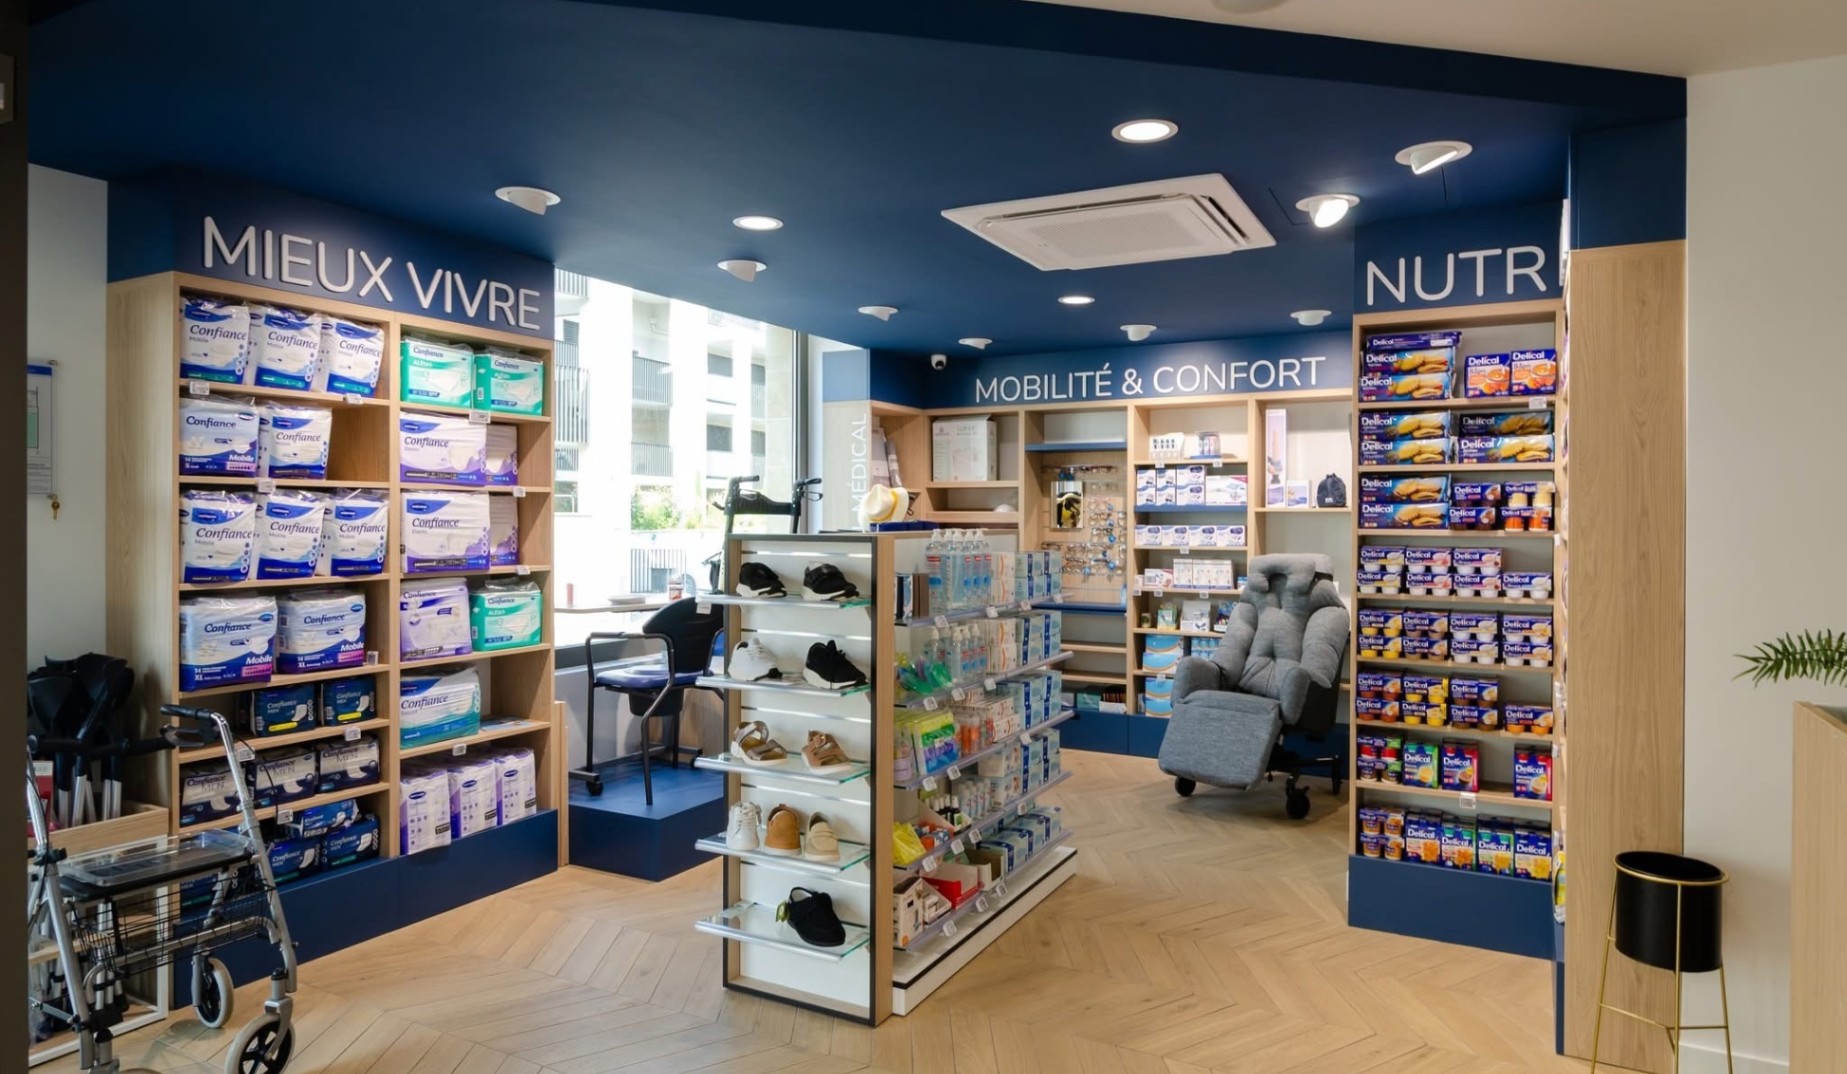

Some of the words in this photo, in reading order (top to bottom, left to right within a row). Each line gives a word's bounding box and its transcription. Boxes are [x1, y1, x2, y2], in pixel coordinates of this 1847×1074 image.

[204, 216, 393, 302] MIEUX
[407, 261, 541, 330] VIVRE
[1367, 245, 1547, 306] NUTR
[189, 324, 247, 341] Confiance
[268, 331, 318, 350] Confiance
[1373, 338, 1394, 346] Delical
[339, 340, 381, 358] Confiance
[1366, 353, 1397, 364] Delical
[1468, 356, 1500, 366] Delical
[1512, 351, 1545, 361] Delical
[975, 362, 1112, 403] MOBILITÉ
[1122, 368, 1143, 395] &
[1152, 356, 1327, 393] CONFORT
[1361, 375, 1392, 387] Delical
[186, 415, 236, 429] Confiance
[1361, 416, 1393, 426] Delical
[1463, 416, 1495, 426] Delical
[276, 431, 321, 443] Confiance
[404, 436, 449, 449] Confiance
[1361, 441, 1393, 451] Delical
[1461, 439, 1495, 450] Delical
[229, 453, 254, 462] Mobile
[1361, 478, 1392, 488] Delical
[1454, 486, 1481, 494] Delical
[1362, 503, 1394, 513] Delical
[1449, 509, 1476, 517] Delical
[412, 517, 460, 529] Confiance
[270, 521, 320, 536] Confiance
[339, 523, 385, 535] Confiance
[196, 527, 253, 541] Confiance
[1361, 550, 1385, 558] Delical
[1406, 550, 1431, 558] Delical
[1454, 552, 1480, 560] Delical
[1357, 572, 1382, 580] Delical
[1407, 573, 1432, 581] Delical
[1454, 575, 1480, 583] Delical
[1503, 575, 1529, 583] Delical
[487, 597, 515, 606] Confiance
[304, 613, 345, 625] Confiance
[1403, 617, 1429, 625] Delical
[1450, 618, 1476, 626] Delical
[1503, 620, 1529, 628] Delical
[204, 623, 252, 634] Confiance
[1359, 637, 1384, 645] Delical
[1403, 640, 1429, 648] Delical
[1451, 641, 1477, 649] Delical
[340, 642, 364, 652] Mobile
[1504, 644, 1530, 652] Delical
[245, 654, 272, 665] Mobile
[1404, 681, 1427, 689] Delical
[1451, 685, 1478, 693] Delical
[336, 691, 361, 699] Confiance
[267, 700, 297, 709] Confiance
[401, 694, 449, 710] Confiance
[1356, 700, 1381, 708] Delical
[1402, 703, 1426, 711] Delical
[1452, 709, 1478, 717] Delical
[1506, 710, 1533, 719] Delical
[322, 747, 358, 758] Confiance
[336, 753, 358, 763] MEN
[1404, 754, 1431, 763] Delical
[1443, 758, 1470, 766] Delical
[259, 760, 296, 771] Confiance
[1516, 764, 1544, 774] Delical
[273, 767, 295, 776] MEN
[186, 775, 226, 787] Confiance
[201, 782, 225, 792] MEN
[1407, 829, 1435, 838] Delical
[1442, 836, 1469, 846] Delical
[1479, 841, 1506, 850] Delical
[1517, 844, 1547, 855] Delical
[272, 849, 301, 862] Confiance
